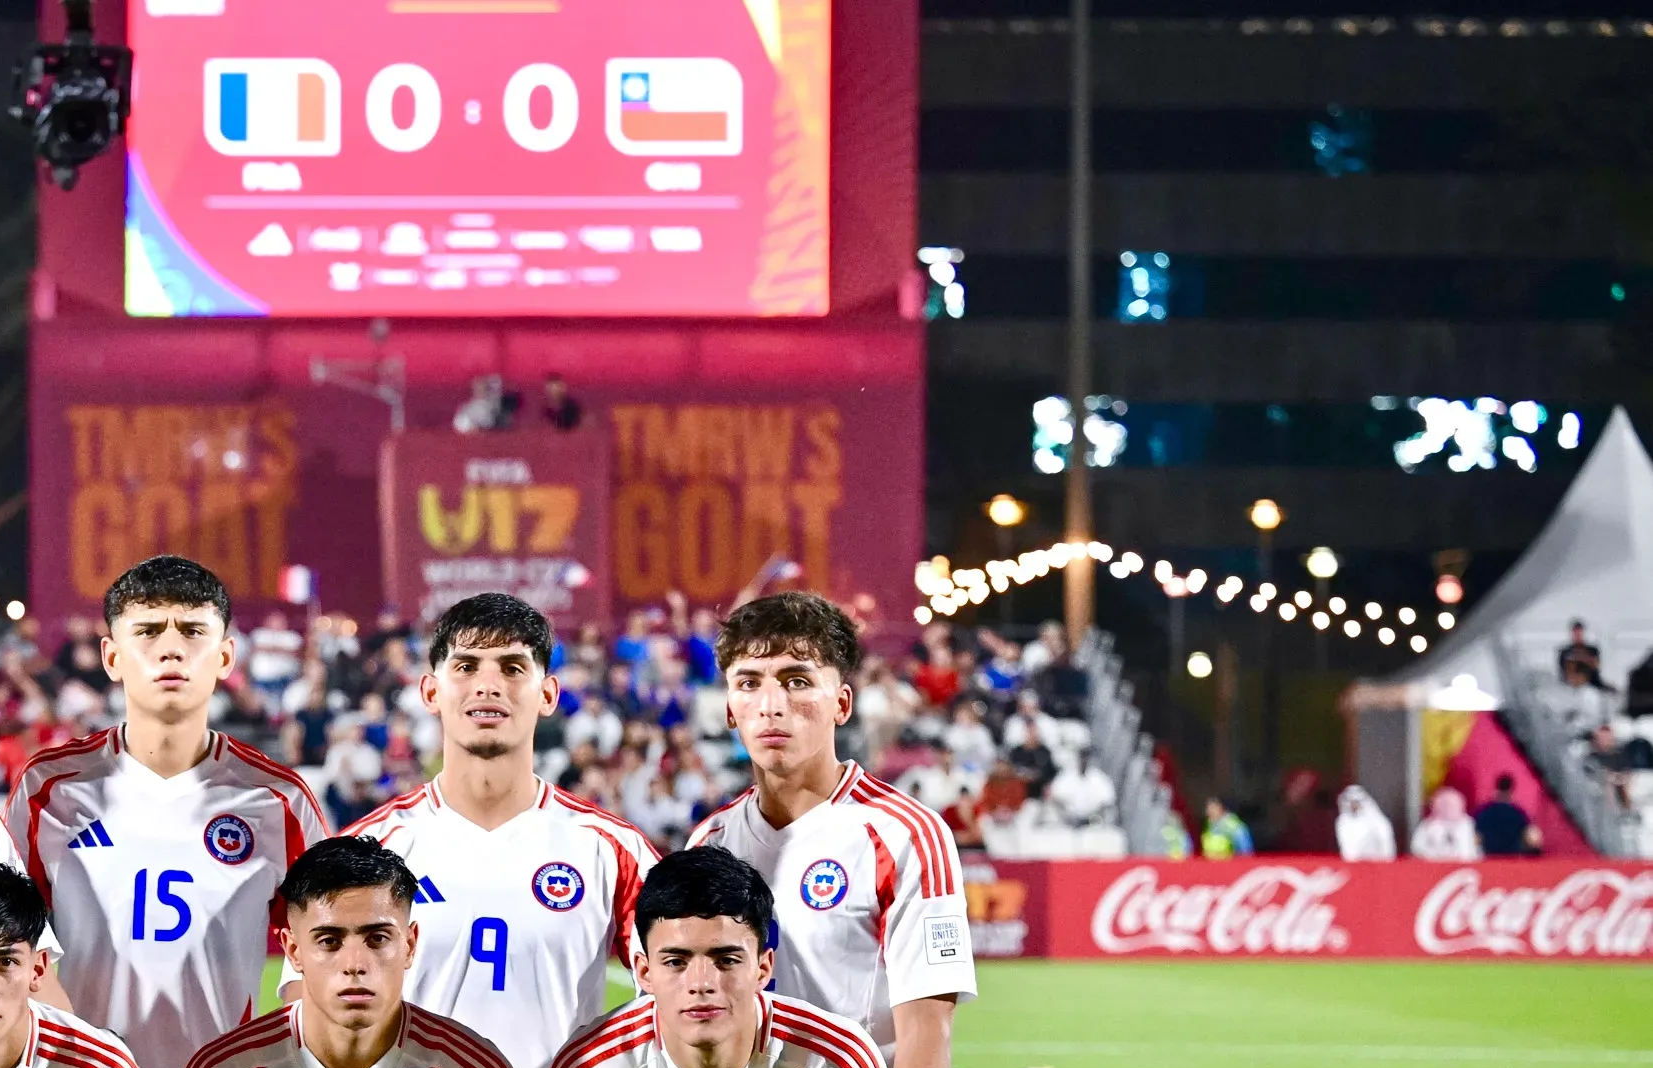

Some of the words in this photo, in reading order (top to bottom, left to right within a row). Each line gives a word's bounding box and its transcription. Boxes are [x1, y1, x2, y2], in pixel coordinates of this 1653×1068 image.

[365, 63, 441, 152] 0
[503, 63, 579, 152] 0
[70, 483, 299, 597] GOAT
[418, 484, 581, 555] U17
[616, 480, 840, 598] GOAT
[132, 869, 193, 941] 15
[931, 923, 958, 931] FOOTBALL
[932, 929, 959, 940] UNITES
[1091, 866, 1349, 954] Coca-Cola
[470, 917, 508, 991] 9
